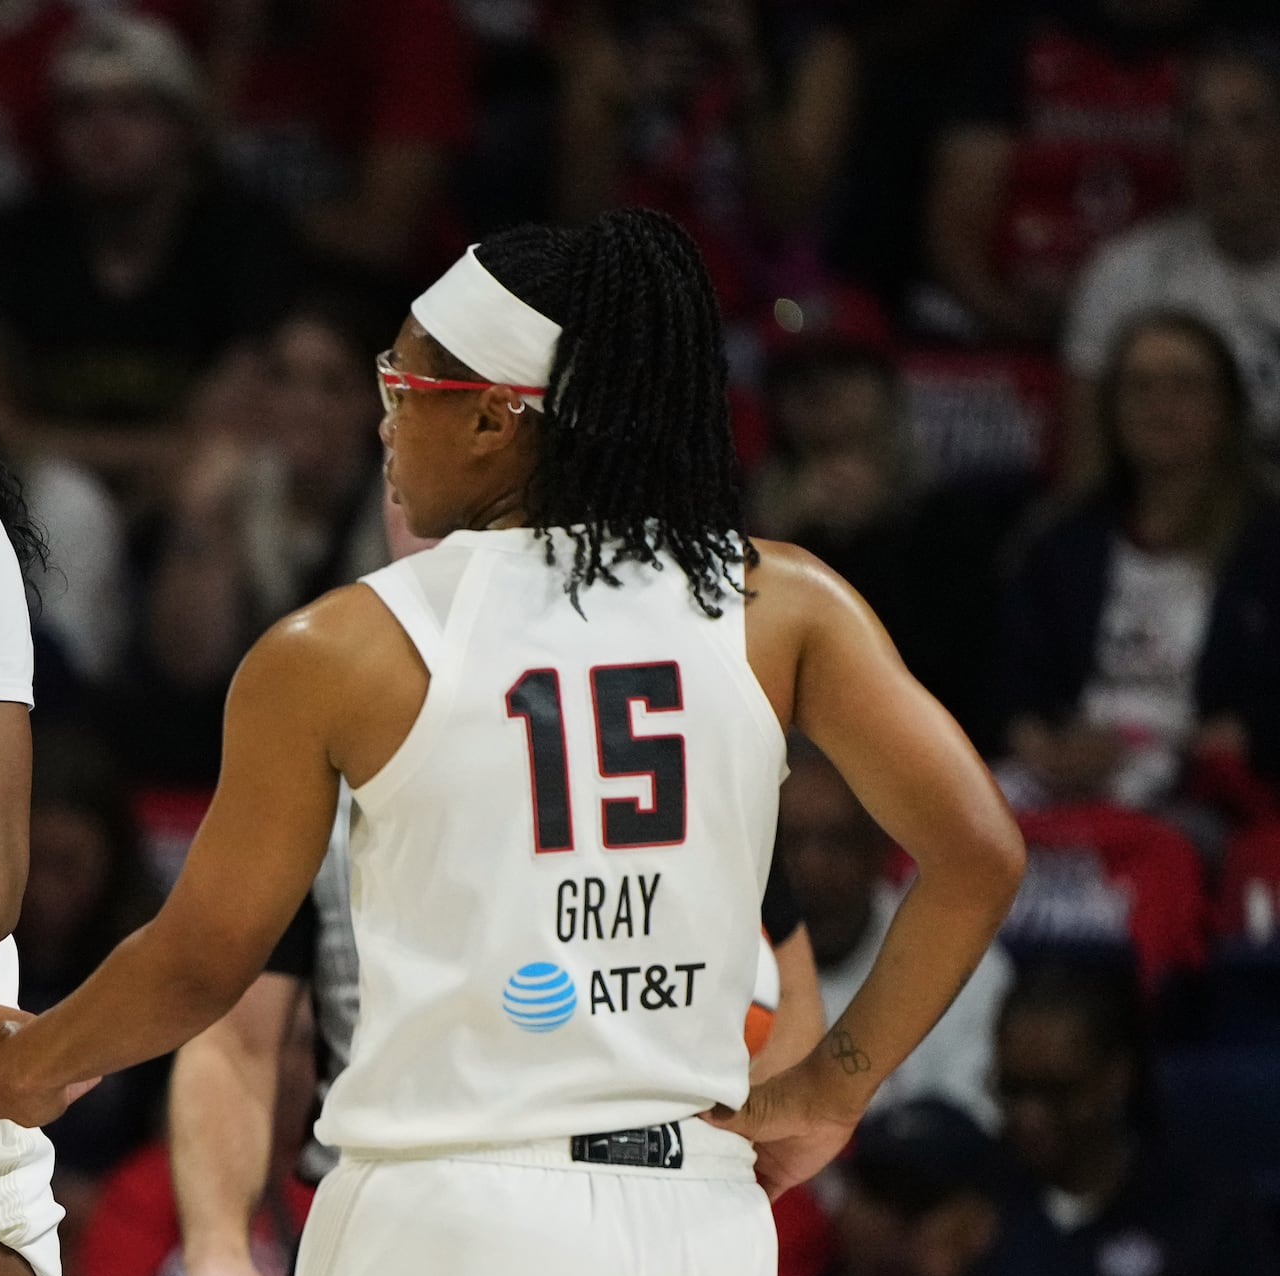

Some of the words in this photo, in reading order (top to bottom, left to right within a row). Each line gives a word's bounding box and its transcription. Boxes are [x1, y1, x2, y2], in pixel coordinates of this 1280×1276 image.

[505, 660, 687, 854] 15
[556, 872, 661, 943] GRAY
[590, 962, 706, 1015] AT&T
